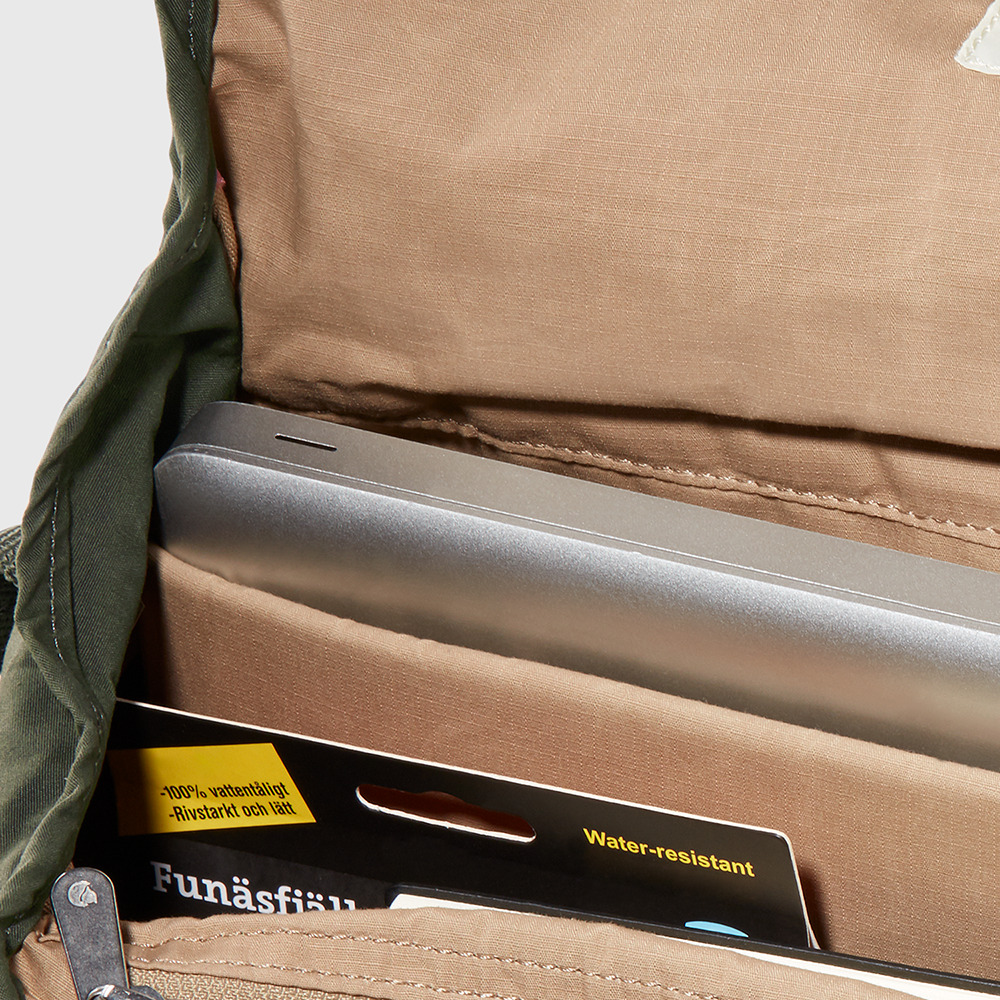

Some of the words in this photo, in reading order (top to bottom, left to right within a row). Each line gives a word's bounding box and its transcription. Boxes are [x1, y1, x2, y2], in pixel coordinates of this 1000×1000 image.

[160, 784, 207, 800] -100%
[208, 780, 290, 800] vattentåligt
[169, 803, 240, 822] -Rivstarkt
[241, 802, 269, 817] och
[268, 801, 297, 816] lätt
[582, 827, 756, 878] Water-resistant
